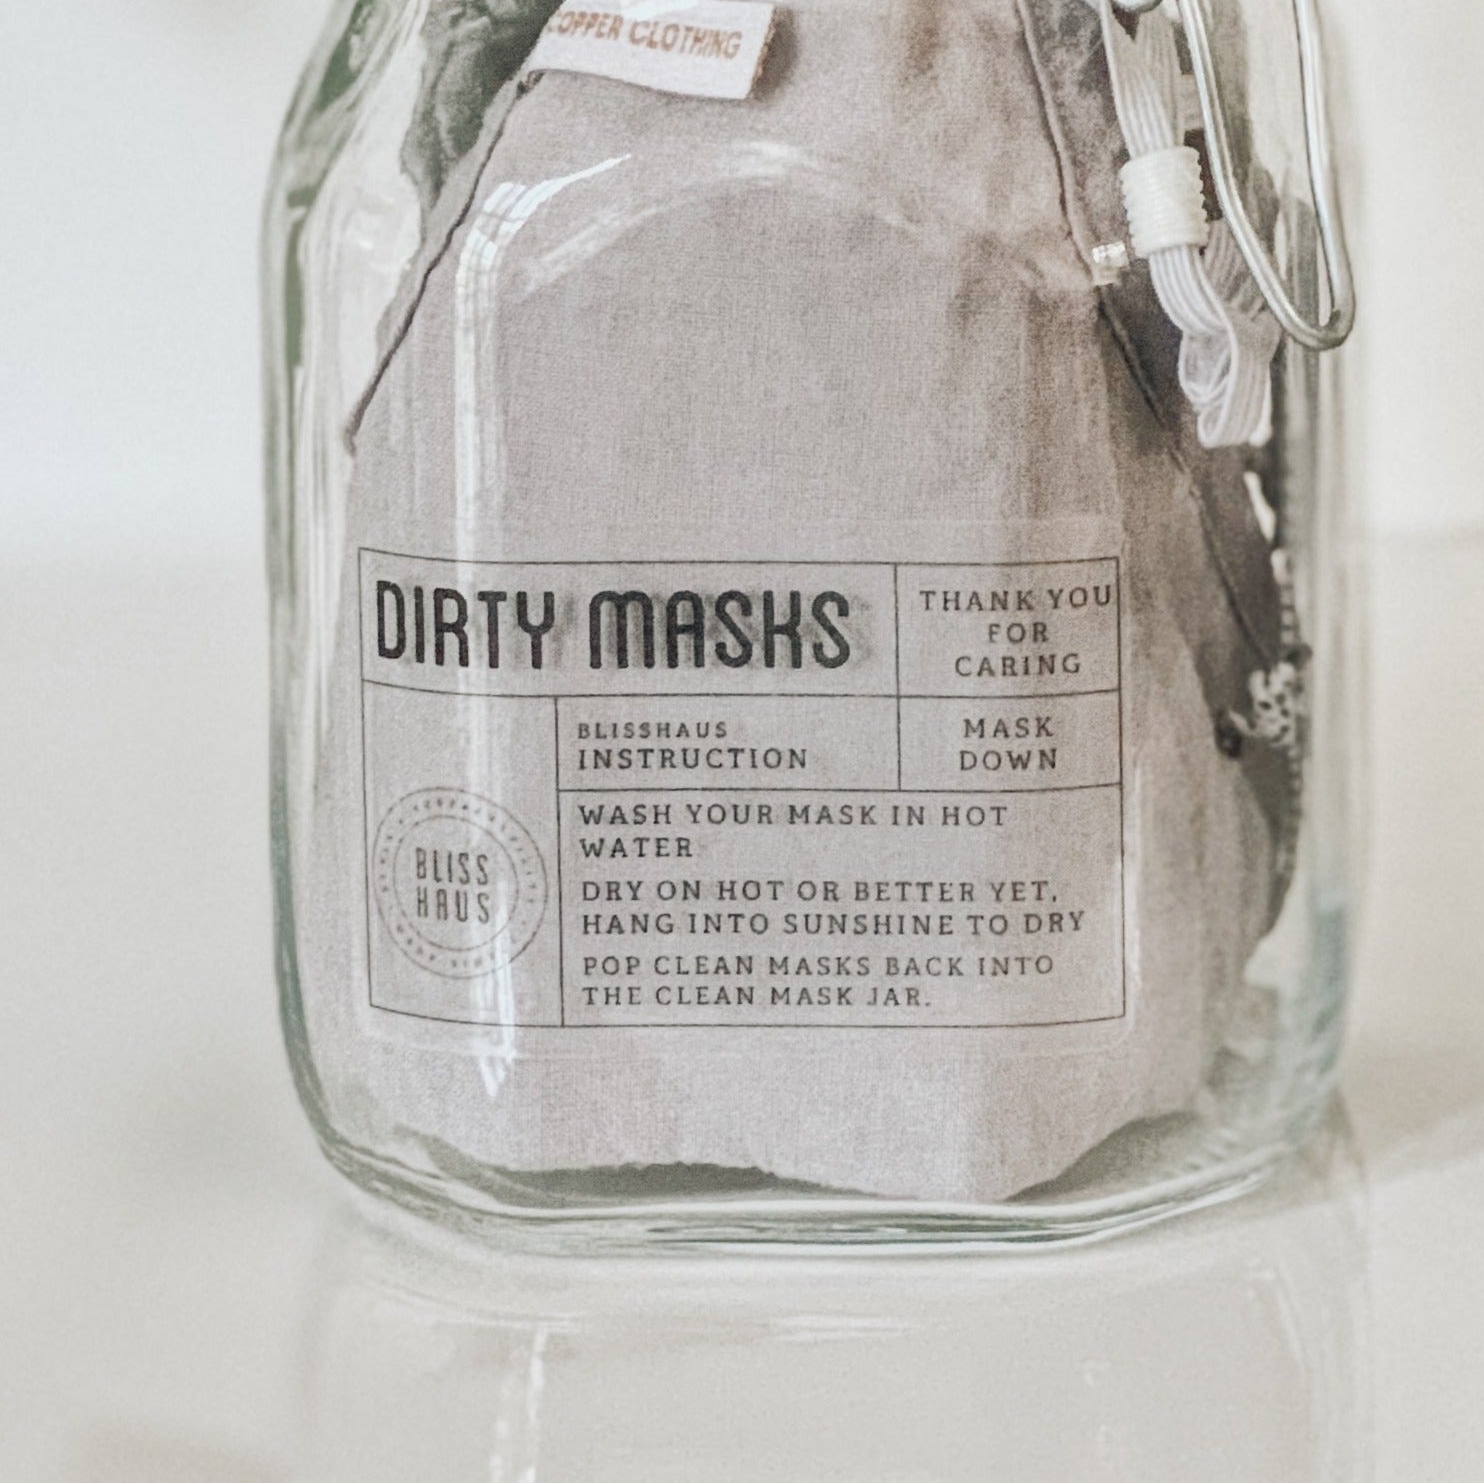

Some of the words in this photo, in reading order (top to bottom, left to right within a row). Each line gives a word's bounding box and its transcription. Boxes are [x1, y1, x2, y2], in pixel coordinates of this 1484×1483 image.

[547, 11, 624, 40] OPPER
[628, 21, 742, 59] CLOTHING
[919, 590, 1036, 612] THANK
[1047, 585, 1112, 610] YOU
[375, 579, 556, 670] DIRTY
[589, 589, 851, 670] MASKS
[988, 621, 1049, 645] FOR
[954, 652, 1081, 677] CARING
[577, 721, 727, 740] BLISSHAUS
[963, 716, 1054, 739] MASK
[578, 747, 807, 771] INSTRUCTION
[959, 747, 1057, 772] DOWN
[577, 803, 672, 826] WASH
[685, 803, 774, 825] YOUR
[786, 804, 877, 826] MASK
[891, 805, 925, 827] IN
[942, 805, 1007, 827] HOT
[579, 837, 693, 859] WATER
[415, 847, 489, 885] BLISS
[582, 880, 643, 902] DRY
[656, 880, 702, 901] ON
[716, 879, 785, 901] HOT
[797, 880, 840, 902] OR
[854, 881, 975, 903] BETTER
[988, 880, 1057, 903] YET,
[416, 887, 490, 924] HAUS
[582, 913, 675, 936] HANG
[688, 913, 770, 935] INTO
[783, 913, 954, 936] SUNSHINE
[966, 914, 1009, 937] TO
[1023, 910, 1085, 934] DRY
[583, 955, 641, 977] POP
[653, 955, 754, 976] CLEAN
[768, 956, 870, 977] MASKS
[885, 956, 964, 977] BACK
[978, 955, 1053, 977] INTO
[582, 986, 641, 1006] THE
[654, 985, 754, 1006] CLEAN
[770, 986, 853, 1006] MASK
[867, 987, 930, 1007] JAR.
